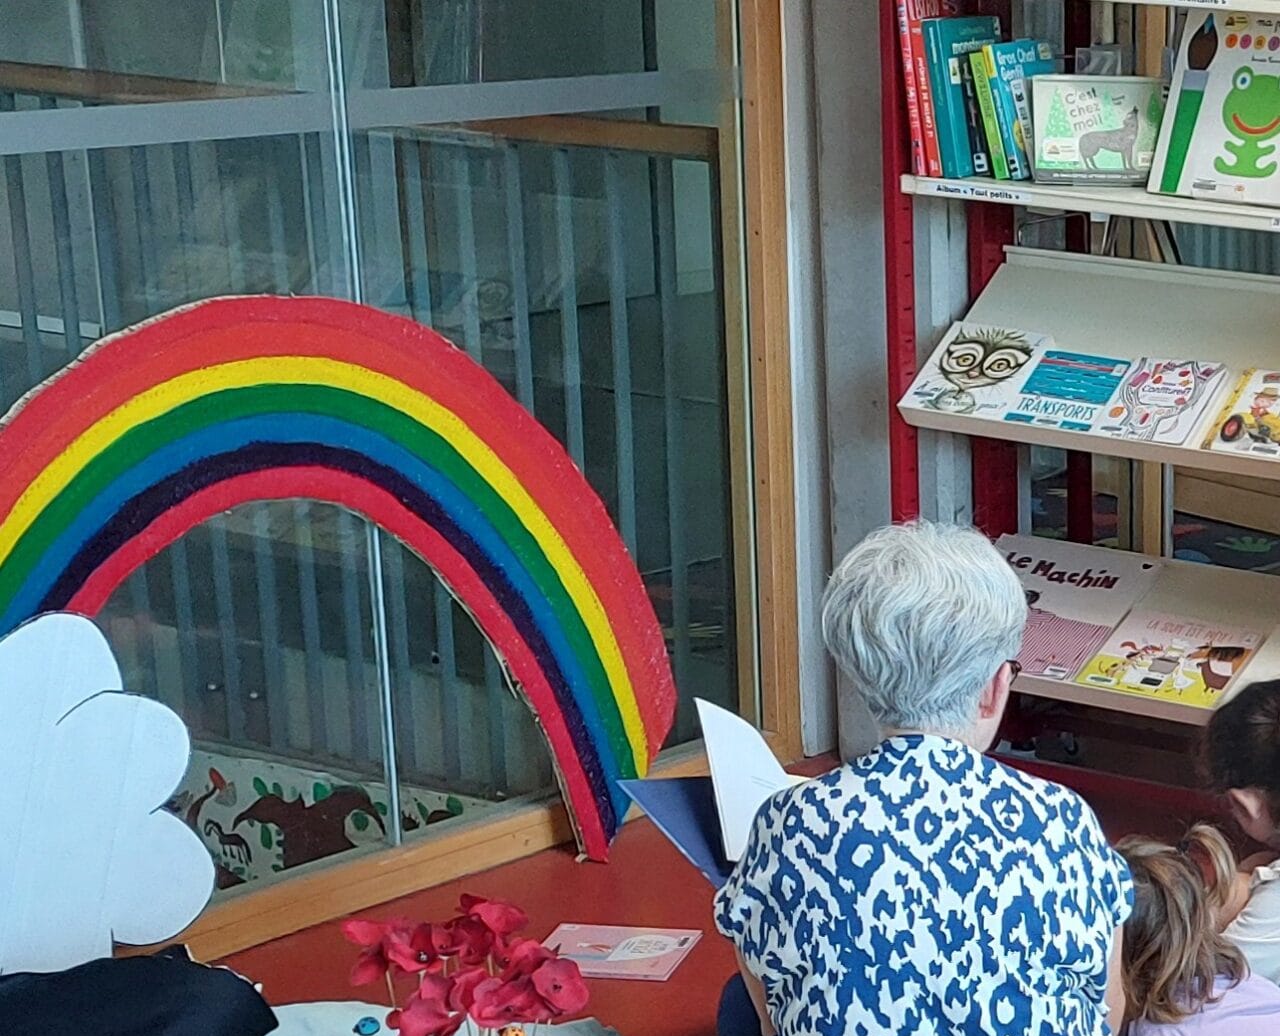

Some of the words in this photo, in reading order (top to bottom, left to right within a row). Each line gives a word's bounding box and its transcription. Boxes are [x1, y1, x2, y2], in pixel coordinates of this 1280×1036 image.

[1065, 87, 1097, 105] C'est
[1070, 102, 1101, 118] chez
[936, 185, 961, 194] Album
[970, 187, 988, 196] Tout
[990, 190, 1012, 199] petits
[1017, 397, 1097, 421] TRANSPORTS
[1006, 551, 1032, 568] Le
